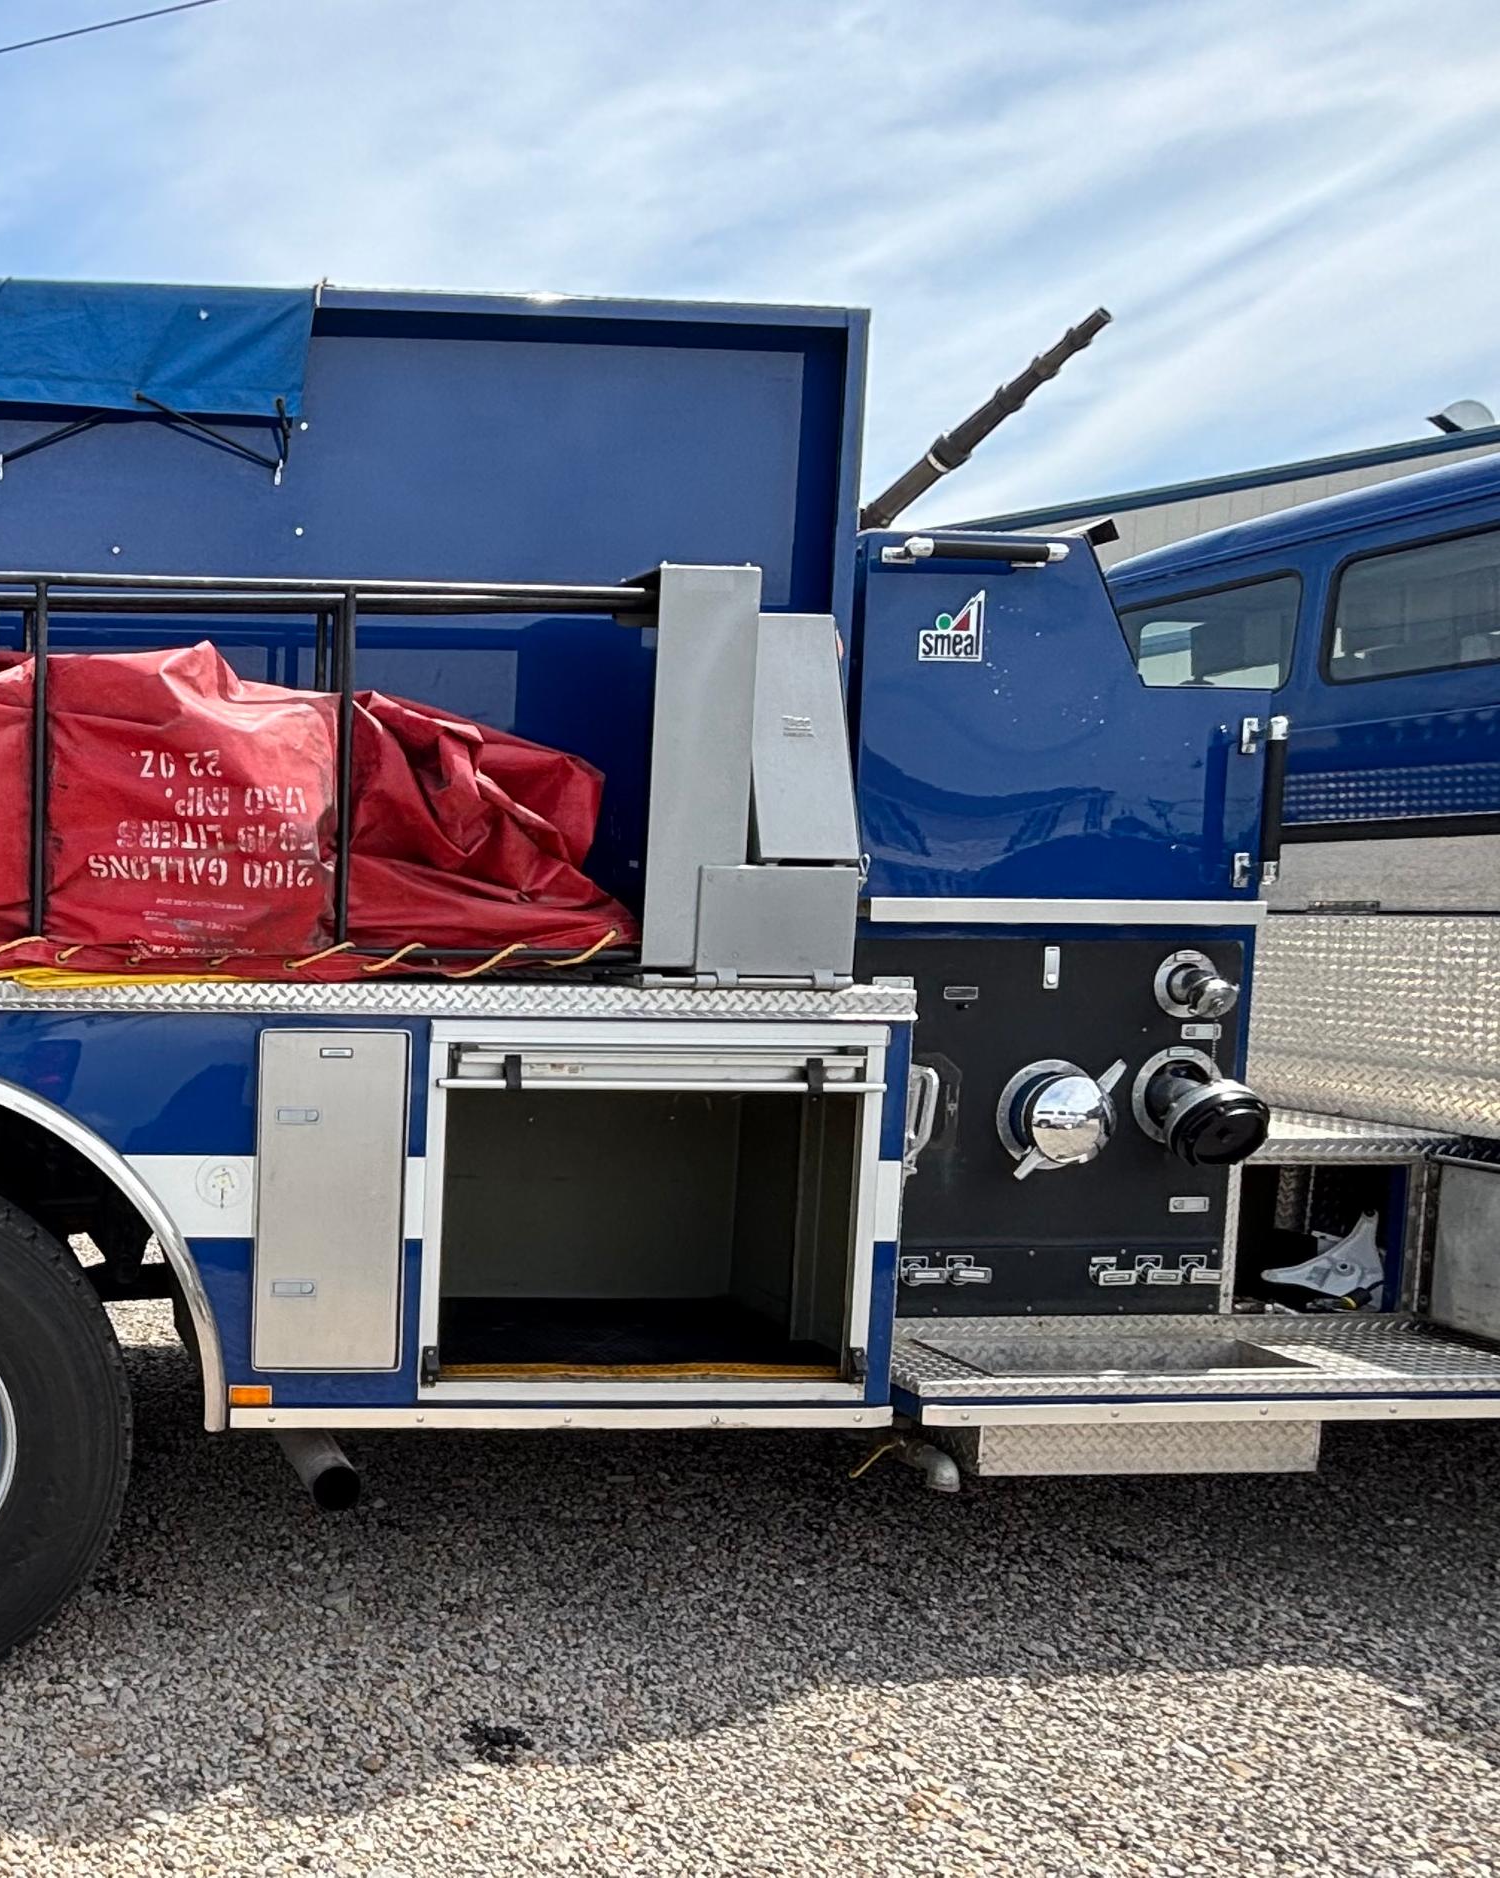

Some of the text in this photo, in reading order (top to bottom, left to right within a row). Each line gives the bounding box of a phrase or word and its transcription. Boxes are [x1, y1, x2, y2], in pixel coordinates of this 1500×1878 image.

[922, 601, 982, 656] smeal
[184, 750, 222, 777] 22
[165, 785, 308, 816] 1750 IMP.
[116, 820, 225, 850] LITERS
[88, 854, 315, 889] 2100 GALLONS
